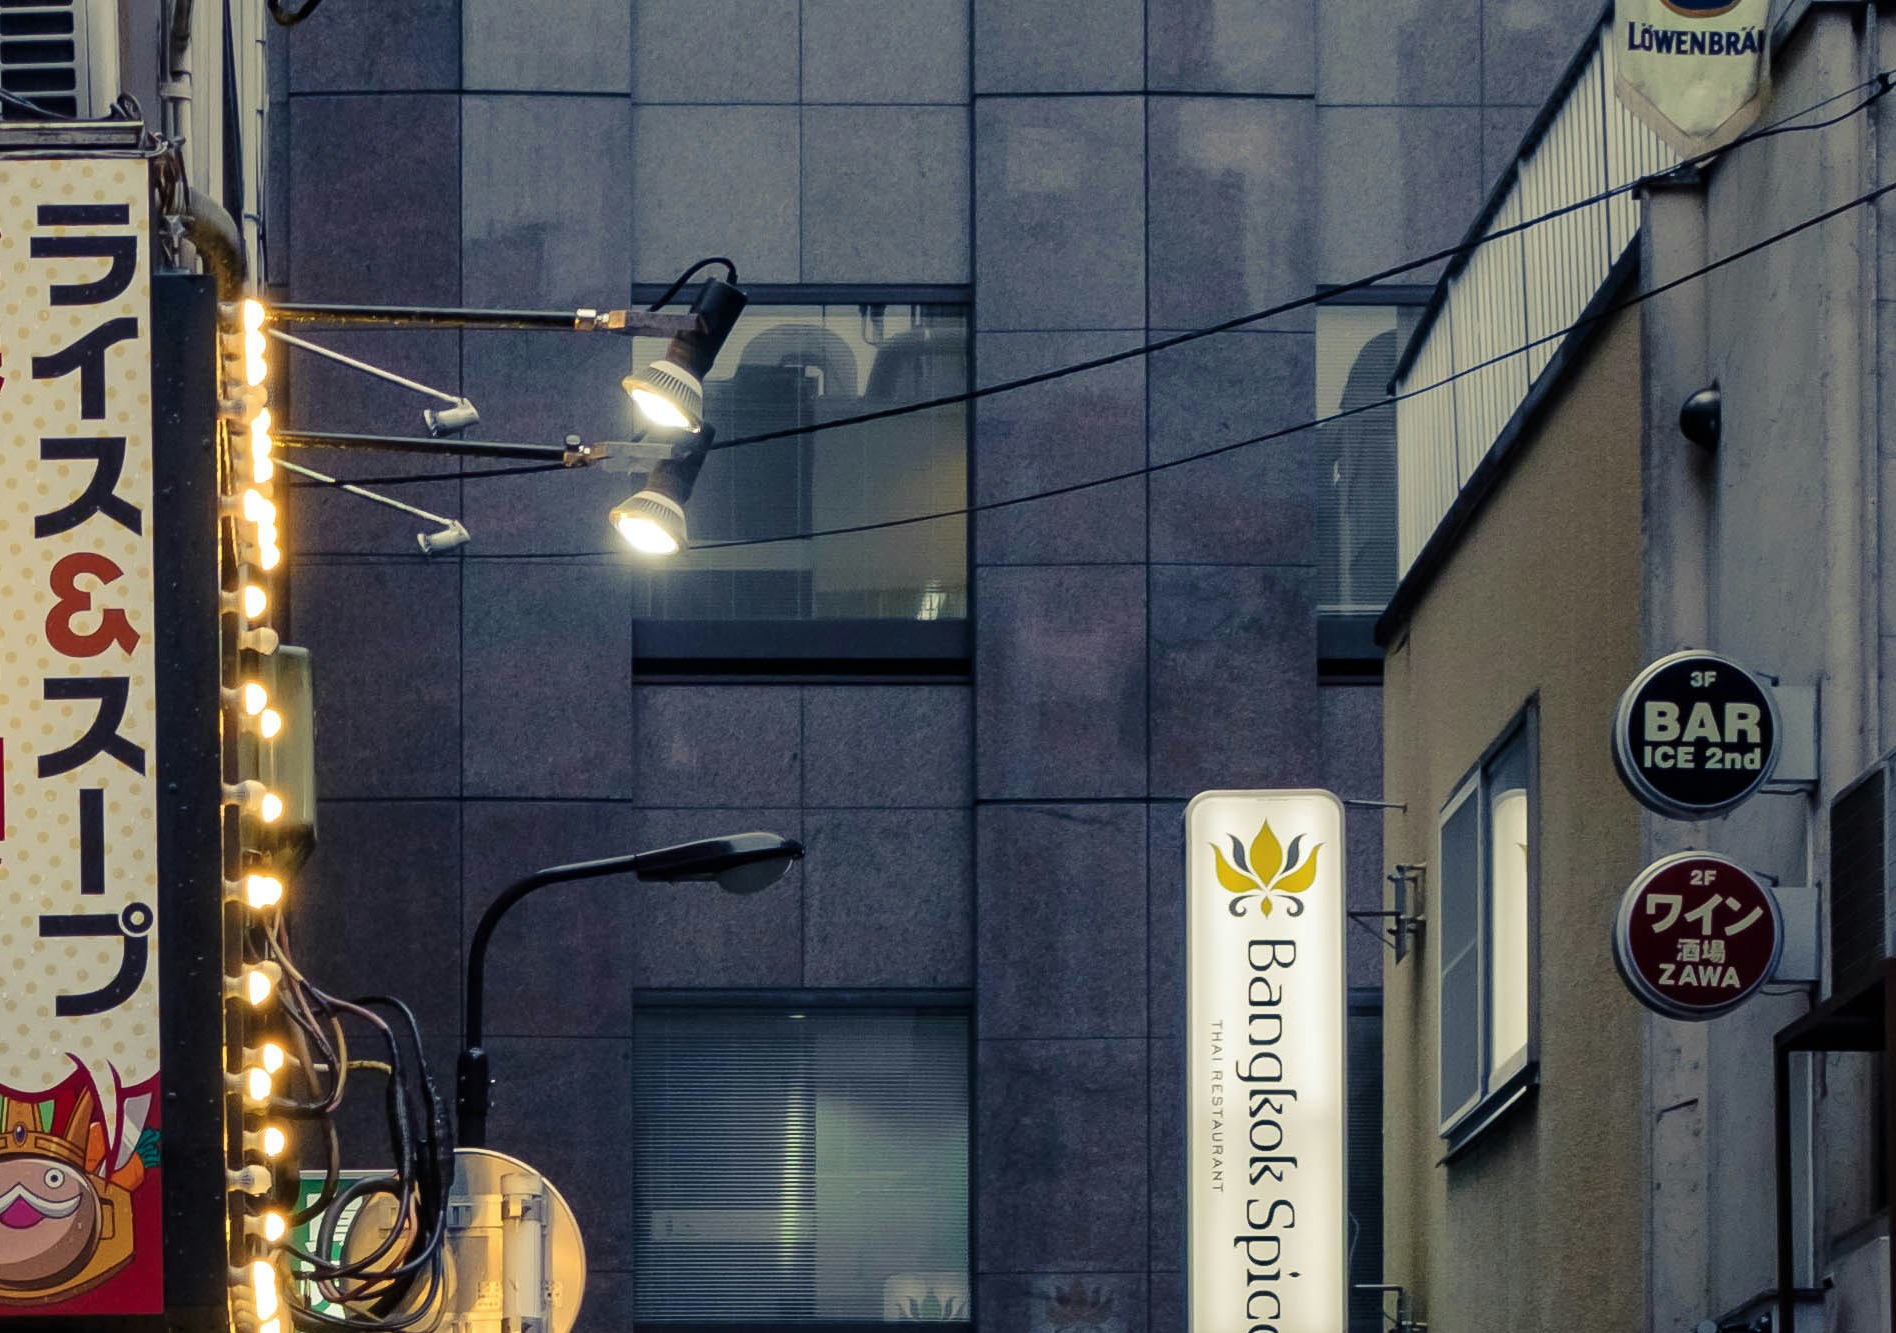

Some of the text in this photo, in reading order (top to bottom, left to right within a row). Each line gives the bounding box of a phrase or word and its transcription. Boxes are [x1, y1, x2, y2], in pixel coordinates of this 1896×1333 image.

[1627, 21, 1764, 56] LÖWENBRÄ
[30, 204, 154, 1015] ライス&スープ
[1690, 670, 1717, 688] 3F
[1644, 701, 1761, 744] BAR
[1644, 747, 1761, 770] ICE 2nd
[1690, 869, 1717, 886] 2F
[1646, 893, 1764, 936] ワイン
[1677, 939, 1726, 963] 酒場
[1658, 963, 1741, 988] ZAWA
[1236, 939, 1298, 1185] Bangkok
[1211, 1019, 1225, 1193] THAI RESTAURANT
